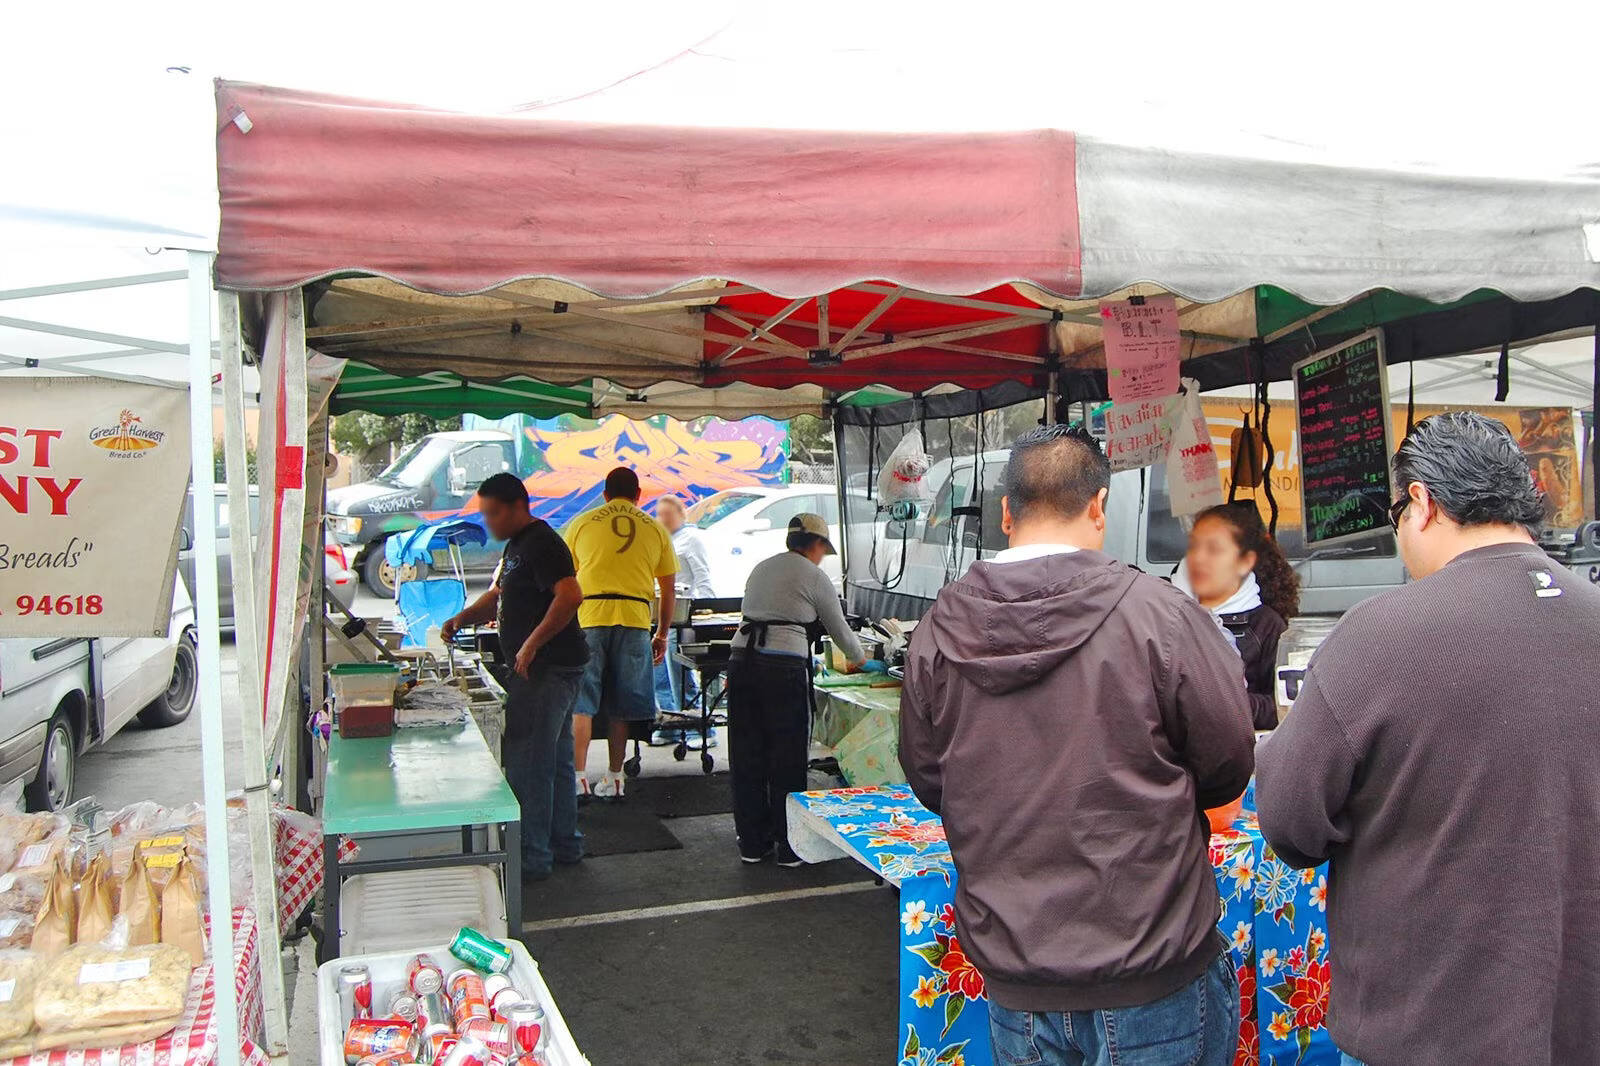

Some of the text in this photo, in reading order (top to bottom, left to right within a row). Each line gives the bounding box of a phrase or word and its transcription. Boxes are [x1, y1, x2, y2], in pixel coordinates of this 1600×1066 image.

[89, 425, 165, 442] Great Harvest
[0, 475, 83, 515] NY
[611, 515, 637, 554] 9
[16, 595, 103, 616] 94618
